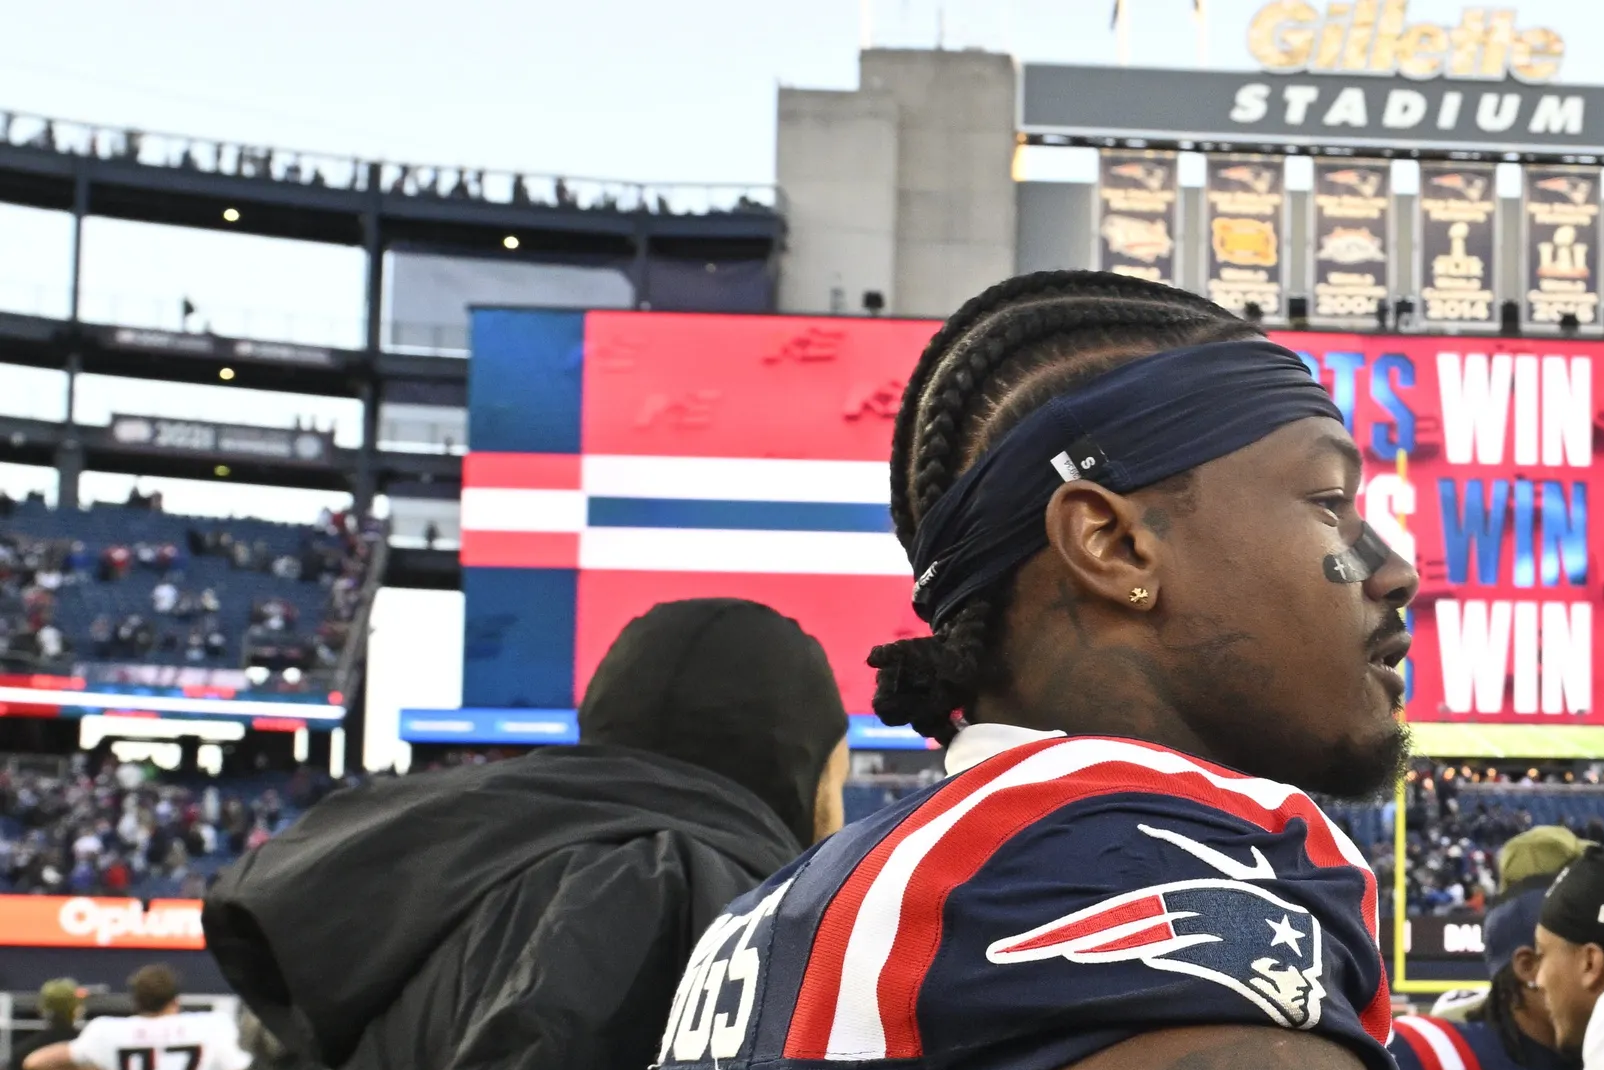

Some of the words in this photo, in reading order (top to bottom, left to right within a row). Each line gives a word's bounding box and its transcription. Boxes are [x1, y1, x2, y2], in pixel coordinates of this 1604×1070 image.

[1247, 0, 1565, 83] Gillette
[1230, 83, 1585, 135] STADIUM
[1427, 301, 1489, 320] 2014
[1436, 352, 1592, 467] WIN
[1438, 477, 1589, 587] WIN
[1435, 600, 1592, 714] WIN
